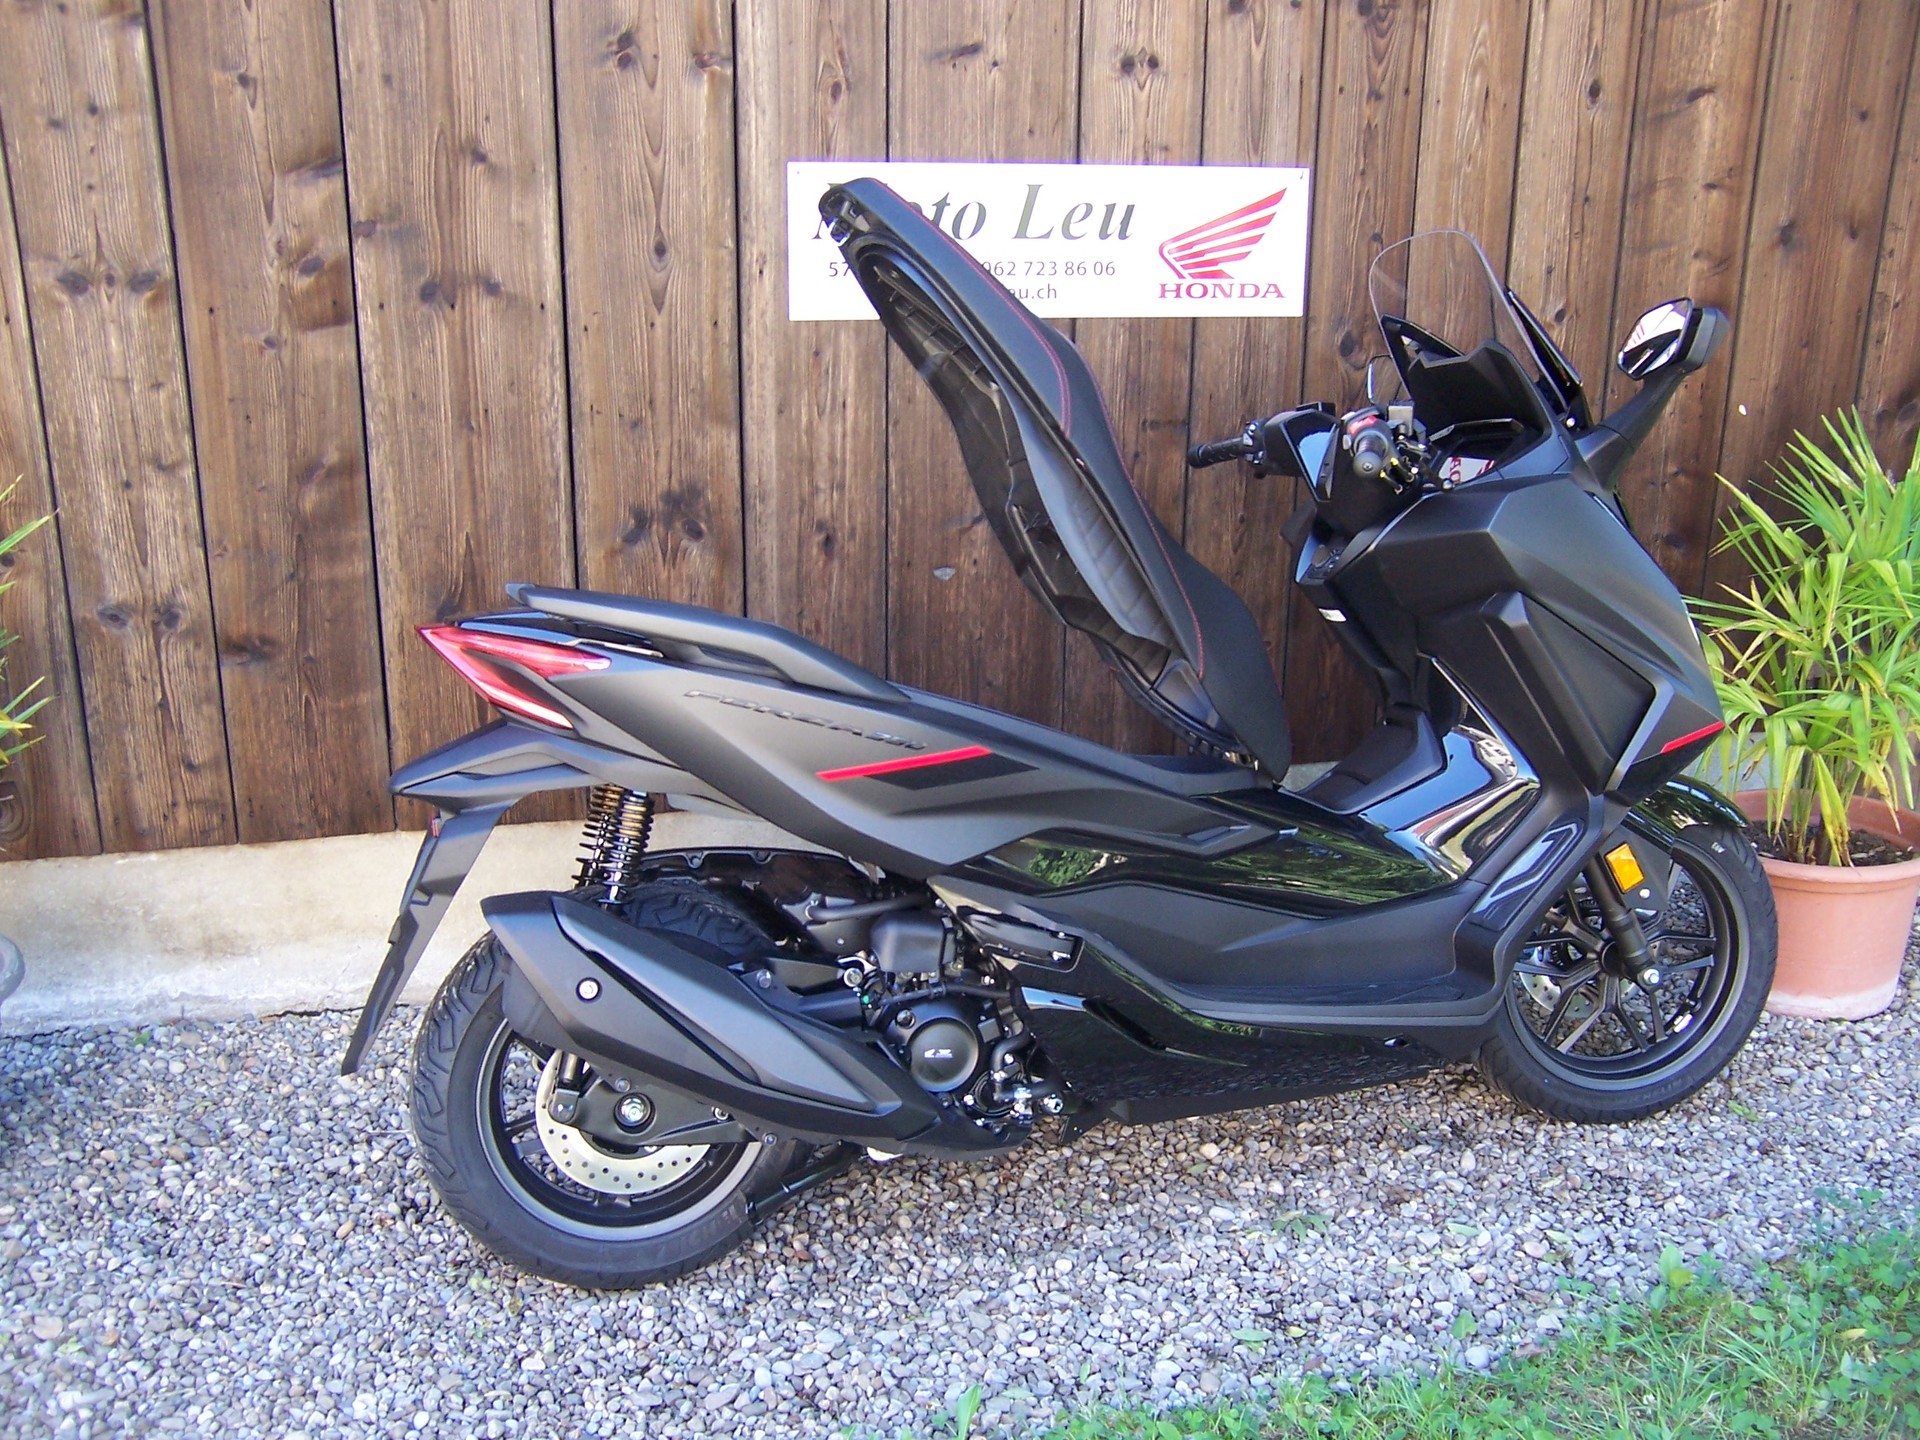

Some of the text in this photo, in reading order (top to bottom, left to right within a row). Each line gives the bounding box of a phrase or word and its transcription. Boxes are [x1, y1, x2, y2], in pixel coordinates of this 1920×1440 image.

[1011, 184, 1136, 240] Leu
[1024, 261, 1057, 276] 723
[1064, 261, 1087, 276] 86
[1093, 261, 1115, 276] 06
[1158, 282, 1286, 299] HONDA
